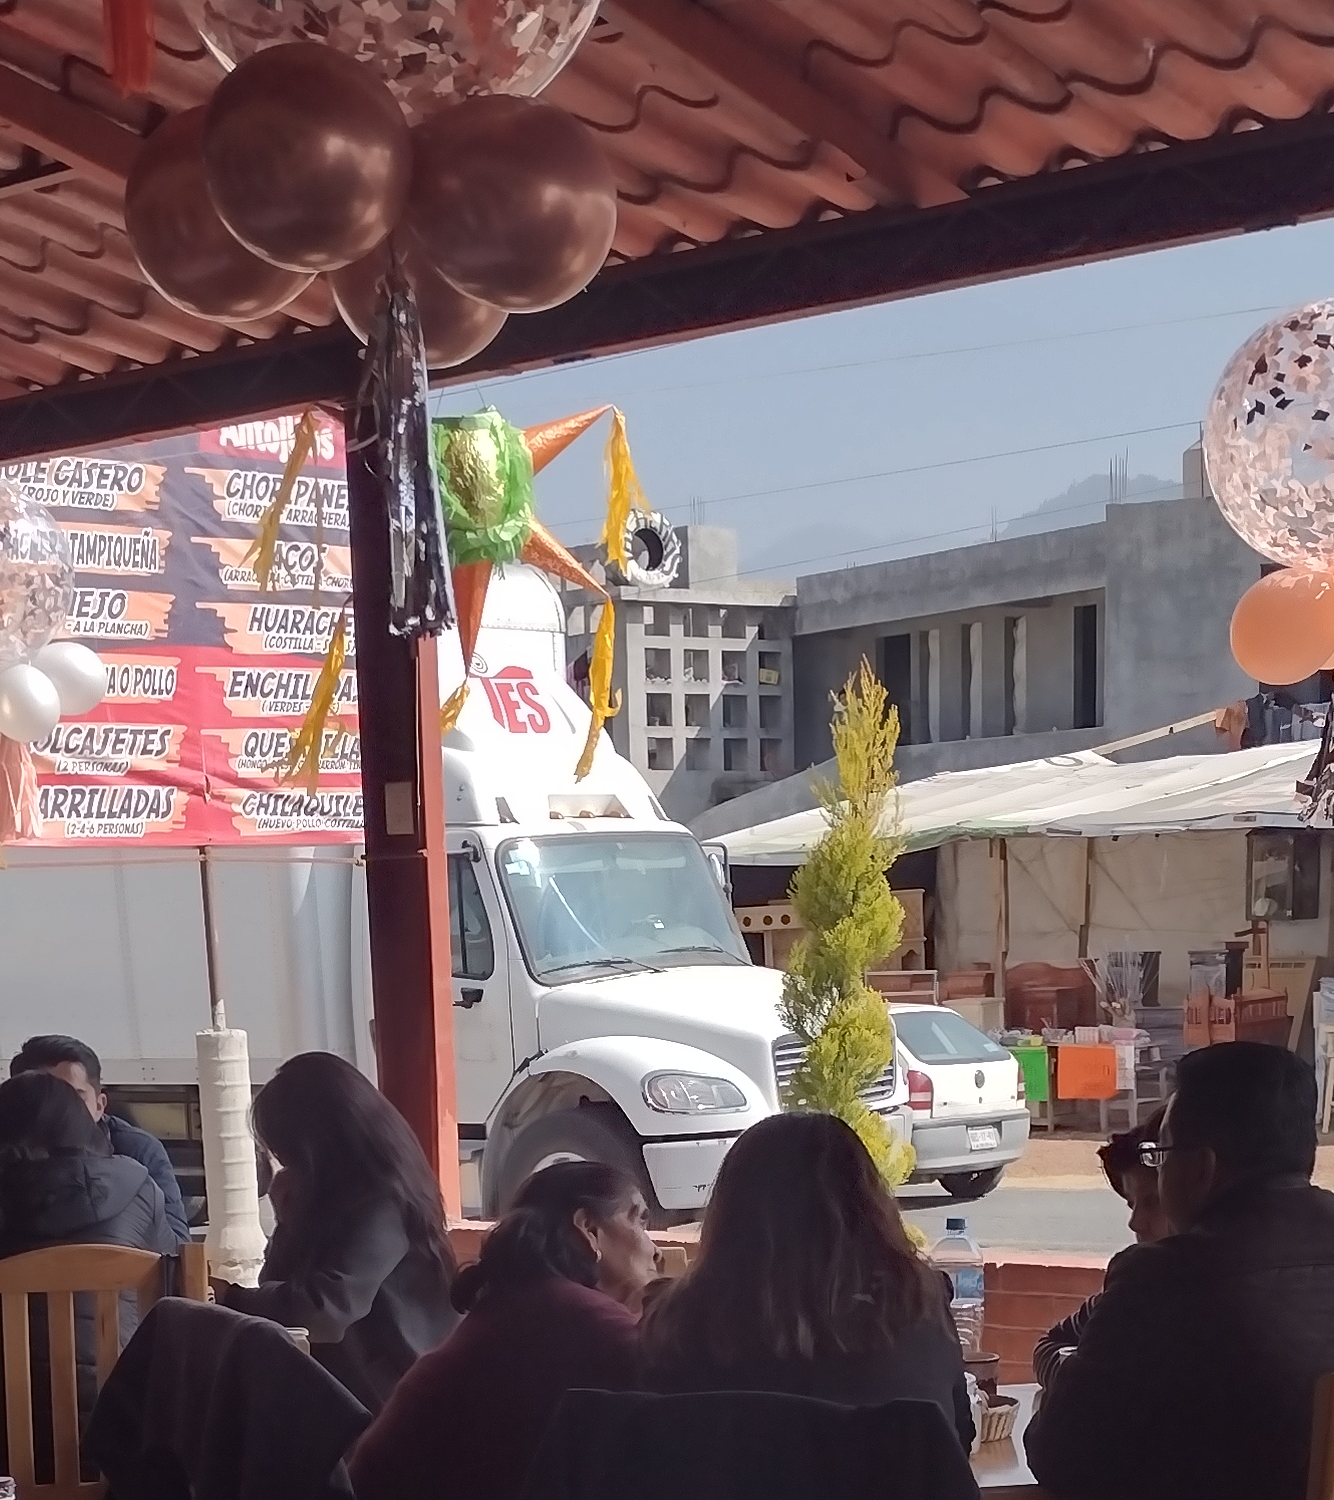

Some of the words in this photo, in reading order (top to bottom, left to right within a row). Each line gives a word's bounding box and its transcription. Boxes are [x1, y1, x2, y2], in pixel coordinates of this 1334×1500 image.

[54, 459, 144, 492] CASERO
[62, 491, 70, 504] Y
[72, 492, 115, 508] VERDE)
[227, 472, 349, 511] CHORPANE
[70, 529, 157, 570] TAMPIQUEÑA
[73, 622, 80, 633] A
[83, 622, 95, 634] LA
[97, 622, 148, 636] PLANCHA)
[249, 607, 355, 637] HUARACHE
[120, 667, 130, 694] O
[133, 667, 175, 696] POLLO
[33, 727, 171, 757] OLCAJETES
[71, 761, 129, 774] PERSONAS)
[40, 788, 175, 820] ARRILLADAS
[243, 792, 363, 817] CHILAQUILE
[67, 822, 95, 835] (2-4-6
[97, 822, 145, 836] PERSONAS)
